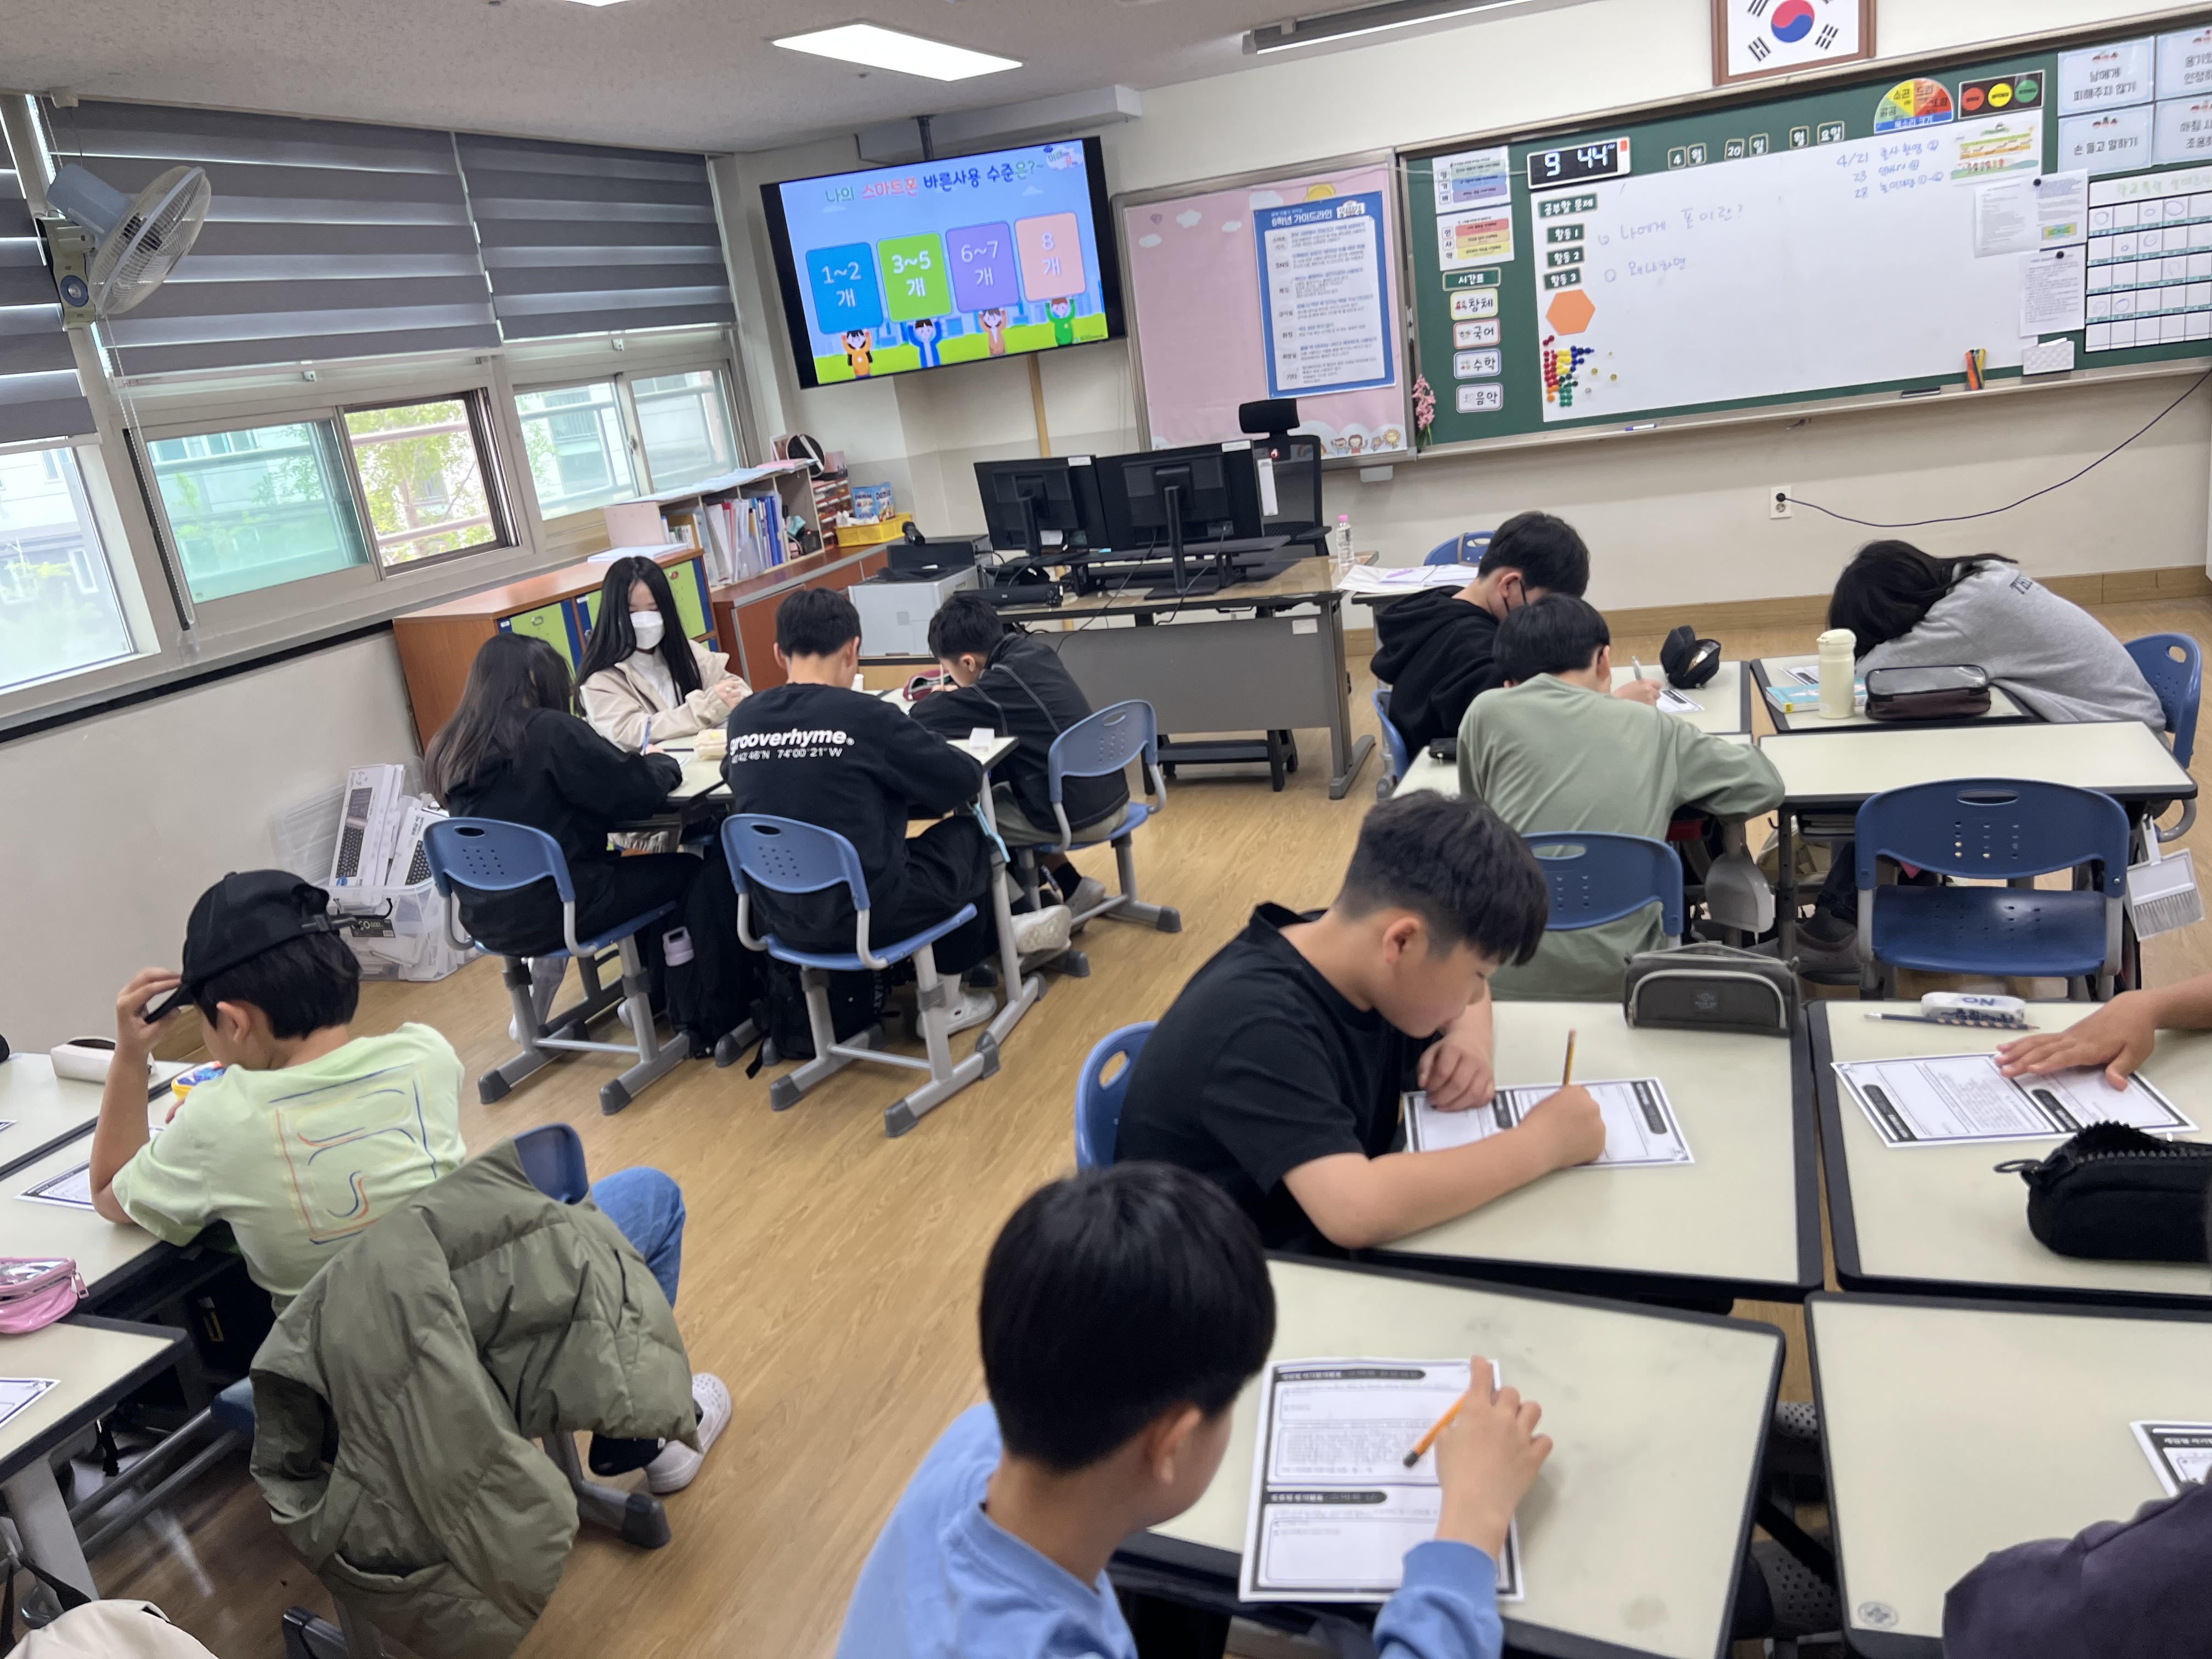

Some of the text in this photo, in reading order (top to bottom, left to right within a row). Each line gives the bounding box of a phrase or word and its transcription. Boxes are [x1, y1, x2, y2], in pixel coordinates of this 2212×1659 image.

[2073, 81, 2136, 101] 피해주지 않기
[1673, 126, 1841, 165] 4 월 20 일 월 요일
[2074, 136, 2138, 155] 손 들고 말하기
[1545, 152, 1560, 177] 9
[1577, 145, 1608, 168] 44
[1836, 152, 1869, 167] 4/21
[825, 186, 855, 202] 나의
[862, 177, 918, 200] 스마트폰
[923, 167, 980, 191] 바른사용
[1294, 208, 1332, 223] 가이드라인
[1544, 198, 1594, 216] 공부할 문제
[1555, 228, 1579, 242] 활동 1
[1620, 221, 1666, 240] 나에게
[1042, 232, 1053, 251] 8
[961, 241, 998, 263] 6~7
[1554, 251, 1580, 265] 활동 2
[891, 250, 932, 274] 3~5
[1043, 257, 1061, 275] 개
[822, 262, 861, 284] 1~2
[975, 267, 994, 286] 개
[1458, 273, 1484, 285] 시간표
[1550, 273, 1576, 287] 활동 3
[906, 277, 926, 297] 개
[836, 288, 856, 308] 개
[1469, 298, 1493, 312] 창체
[1474, 326, 1494, 340] 국어
[1474, 357, 1496, 371] 수학
[1476, 391, 1498, 405] 음악
